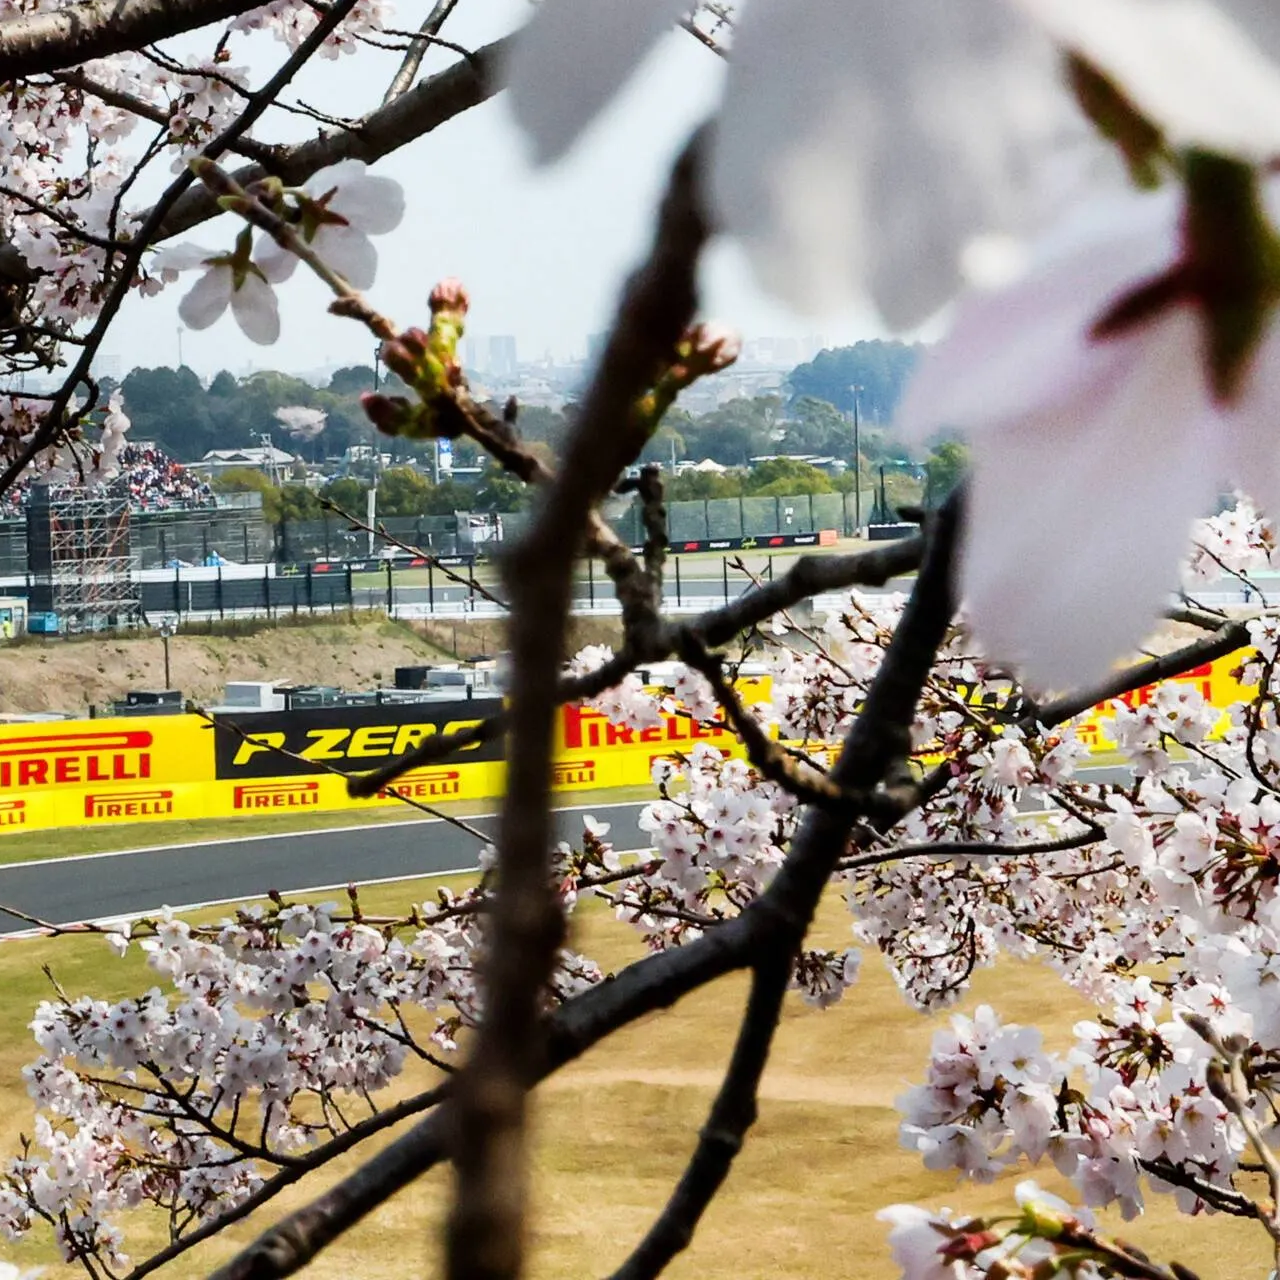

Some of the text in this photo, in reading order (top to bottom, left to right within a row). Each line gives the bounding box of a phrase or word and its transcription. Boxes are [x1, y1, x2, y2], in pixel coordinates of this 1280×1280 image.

[233, 732, 285, 765] P
[85, 791, 173, 818] PIRELLI
[233, 782, 319, 809] PIRELLI
